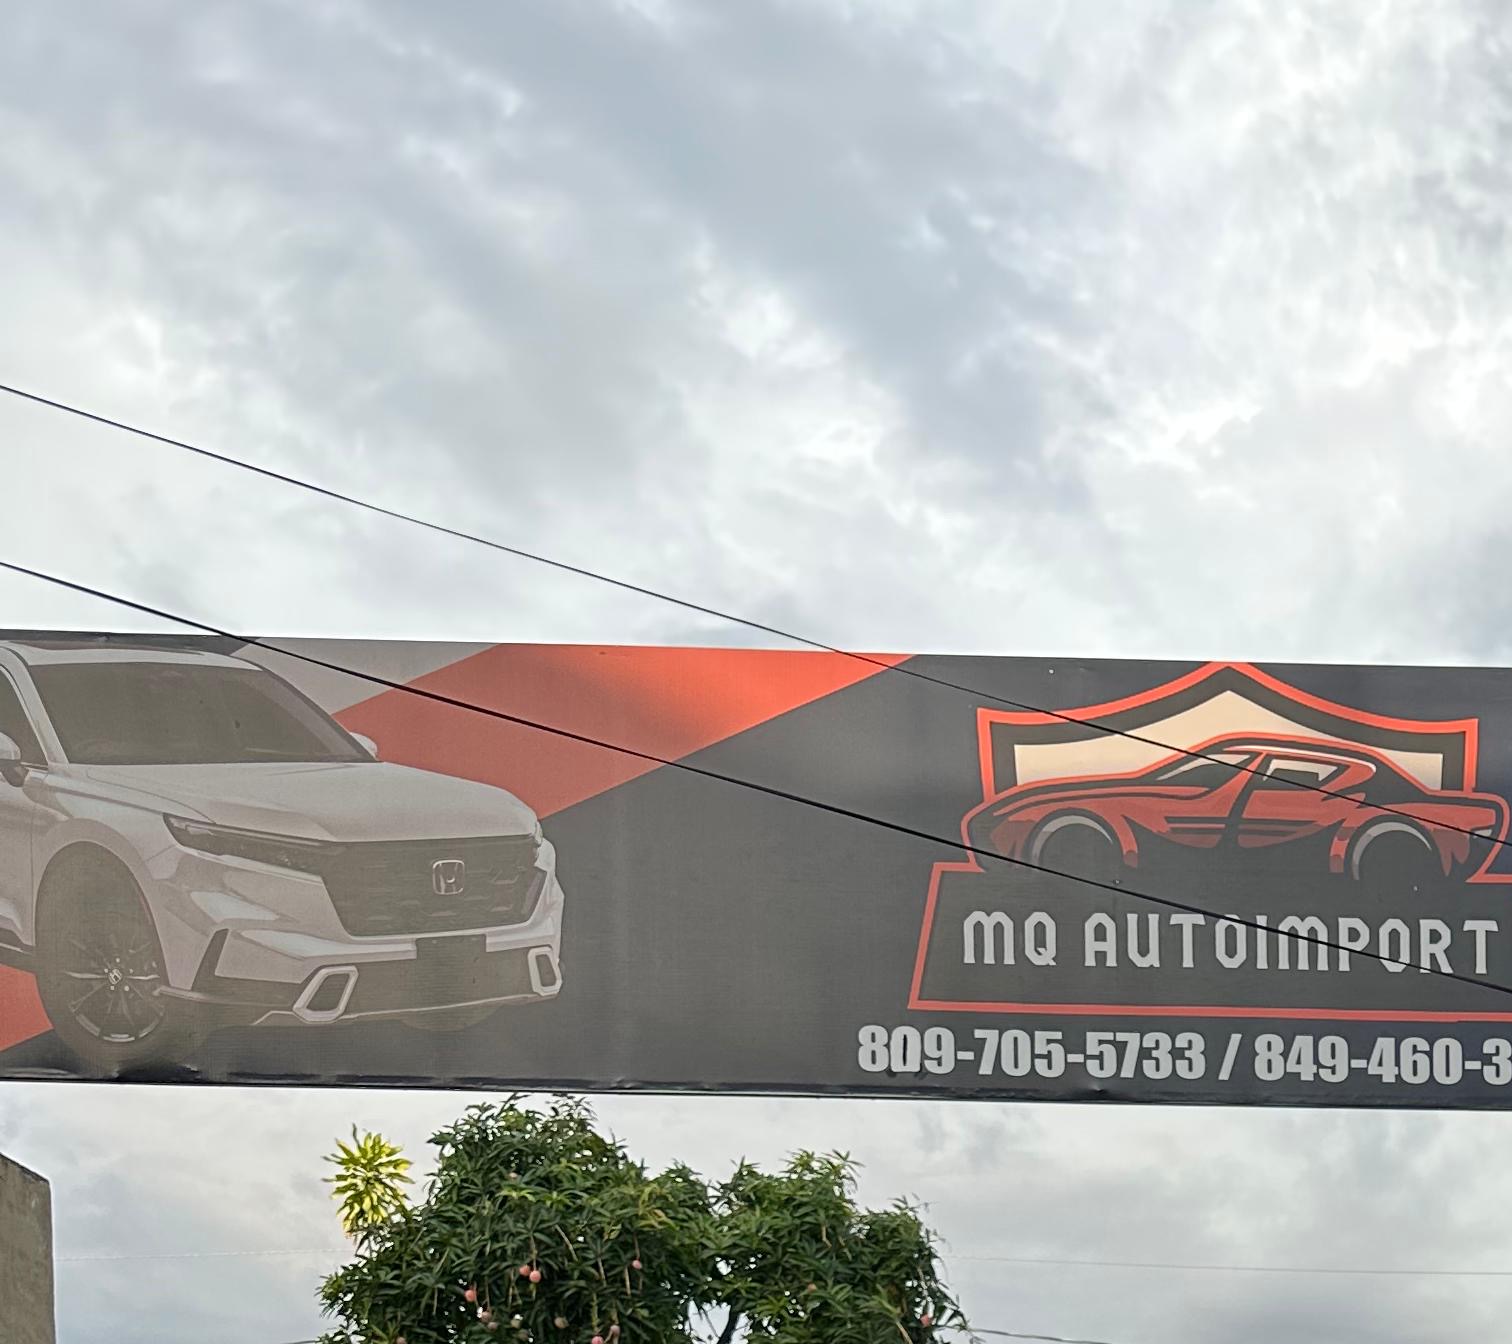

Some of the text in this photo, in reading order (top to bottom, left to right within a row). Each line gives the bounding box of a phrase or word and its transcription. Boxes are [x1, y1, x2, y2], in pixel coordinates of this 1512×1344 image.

[963, 910, 1499, 975] MQ AUTOIMPORT
[857, 1024, 1207, 1081] 809-705-5733
